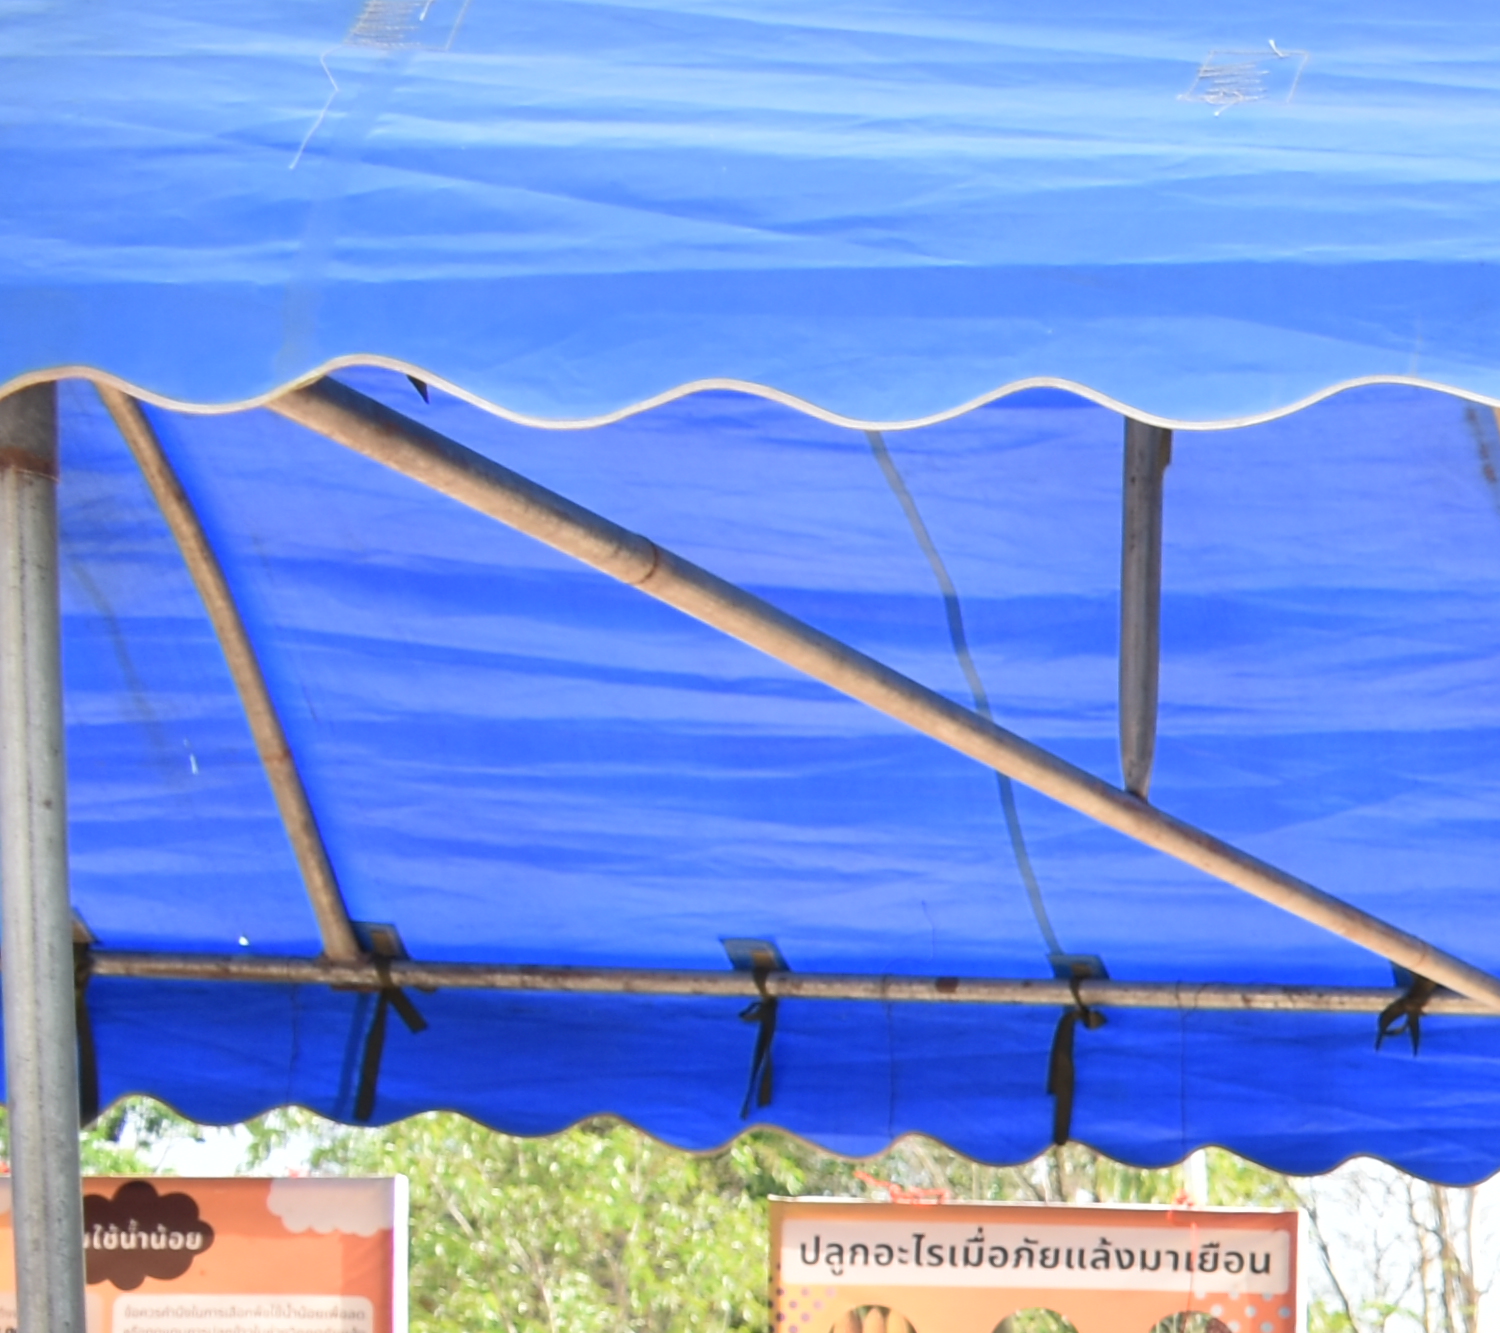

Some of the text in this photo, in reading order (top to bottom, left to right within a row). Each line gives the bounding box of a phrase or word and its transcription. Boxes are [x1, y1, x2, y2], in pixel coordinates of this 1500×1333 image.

[800, 1231, 1272, 1277] ปลูกอะไรเมื่อภัยแล้งมาเยือน
